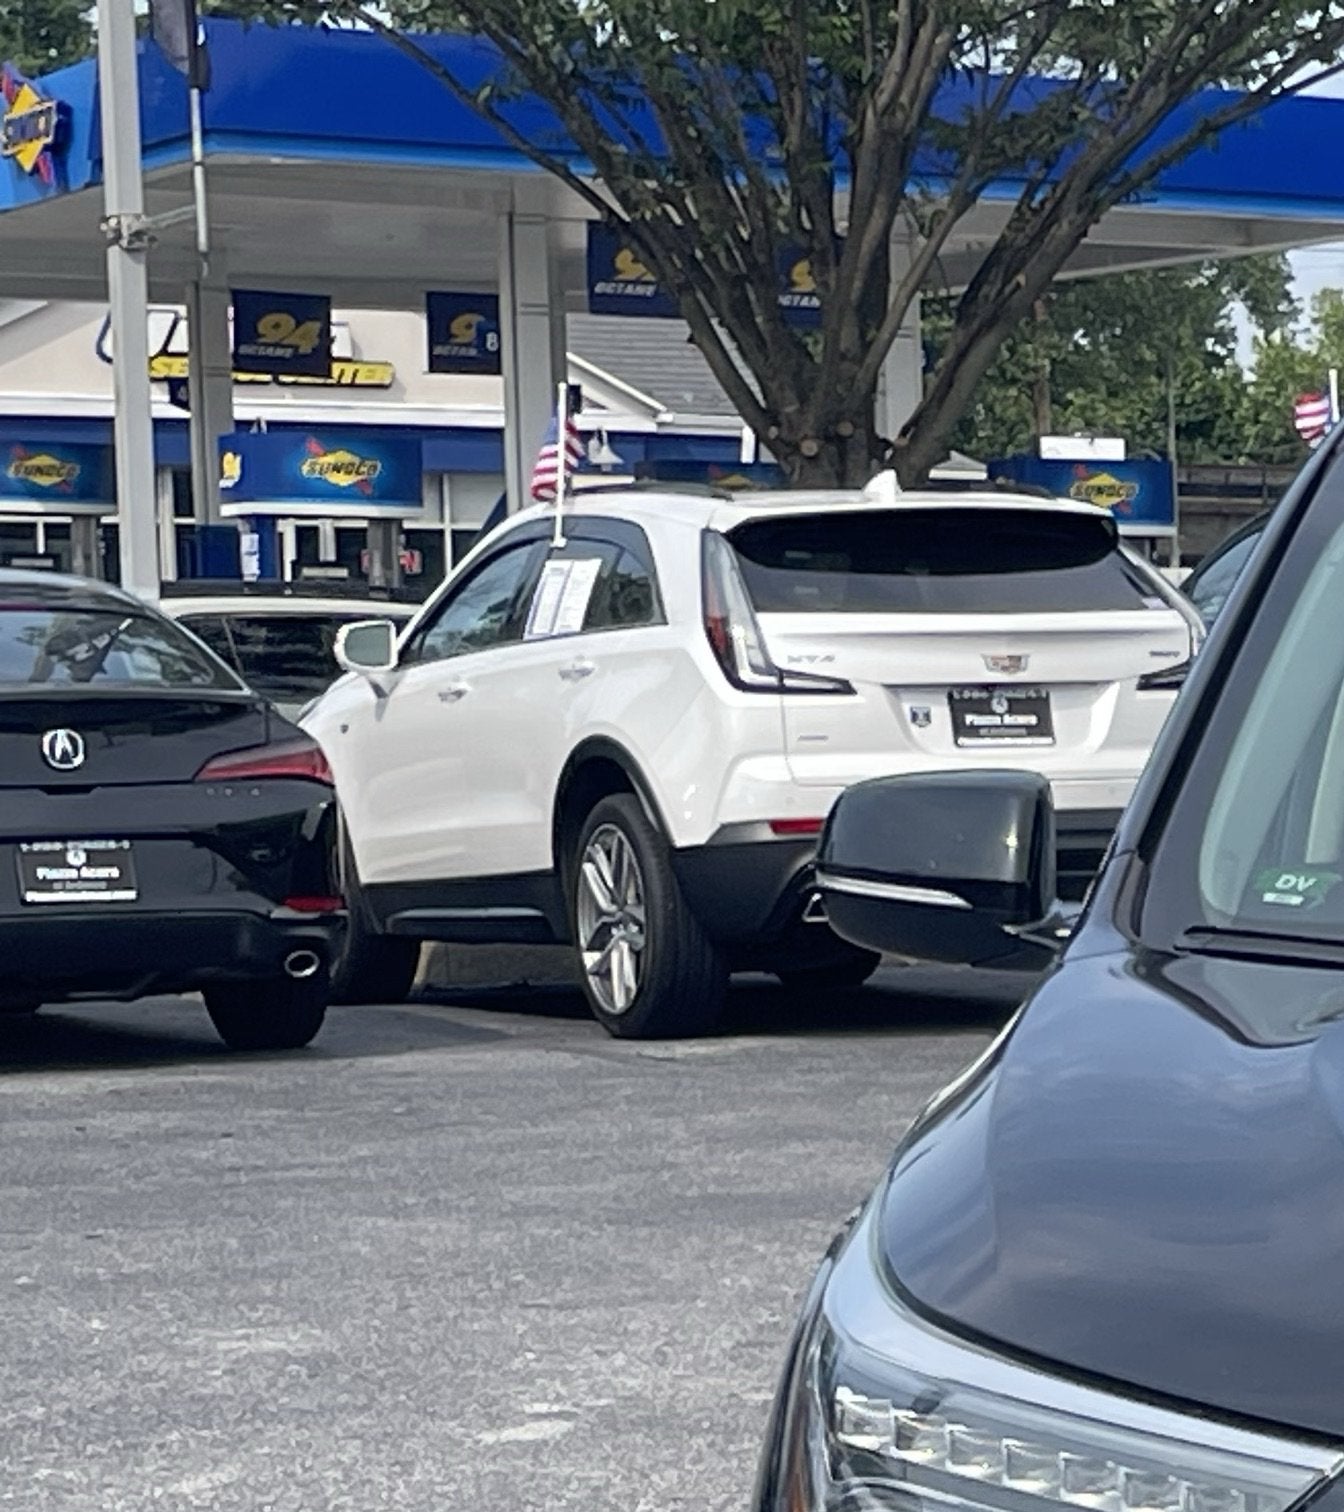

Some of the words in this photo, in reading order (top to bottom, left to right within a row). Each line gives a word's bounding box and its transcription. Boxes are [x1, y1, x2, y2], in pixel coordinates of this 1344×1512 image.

[257, 312, 321, 354] 94
[307, 459, 379, 476] SUNOCO
[1275, 874, 1317, 892] DV
